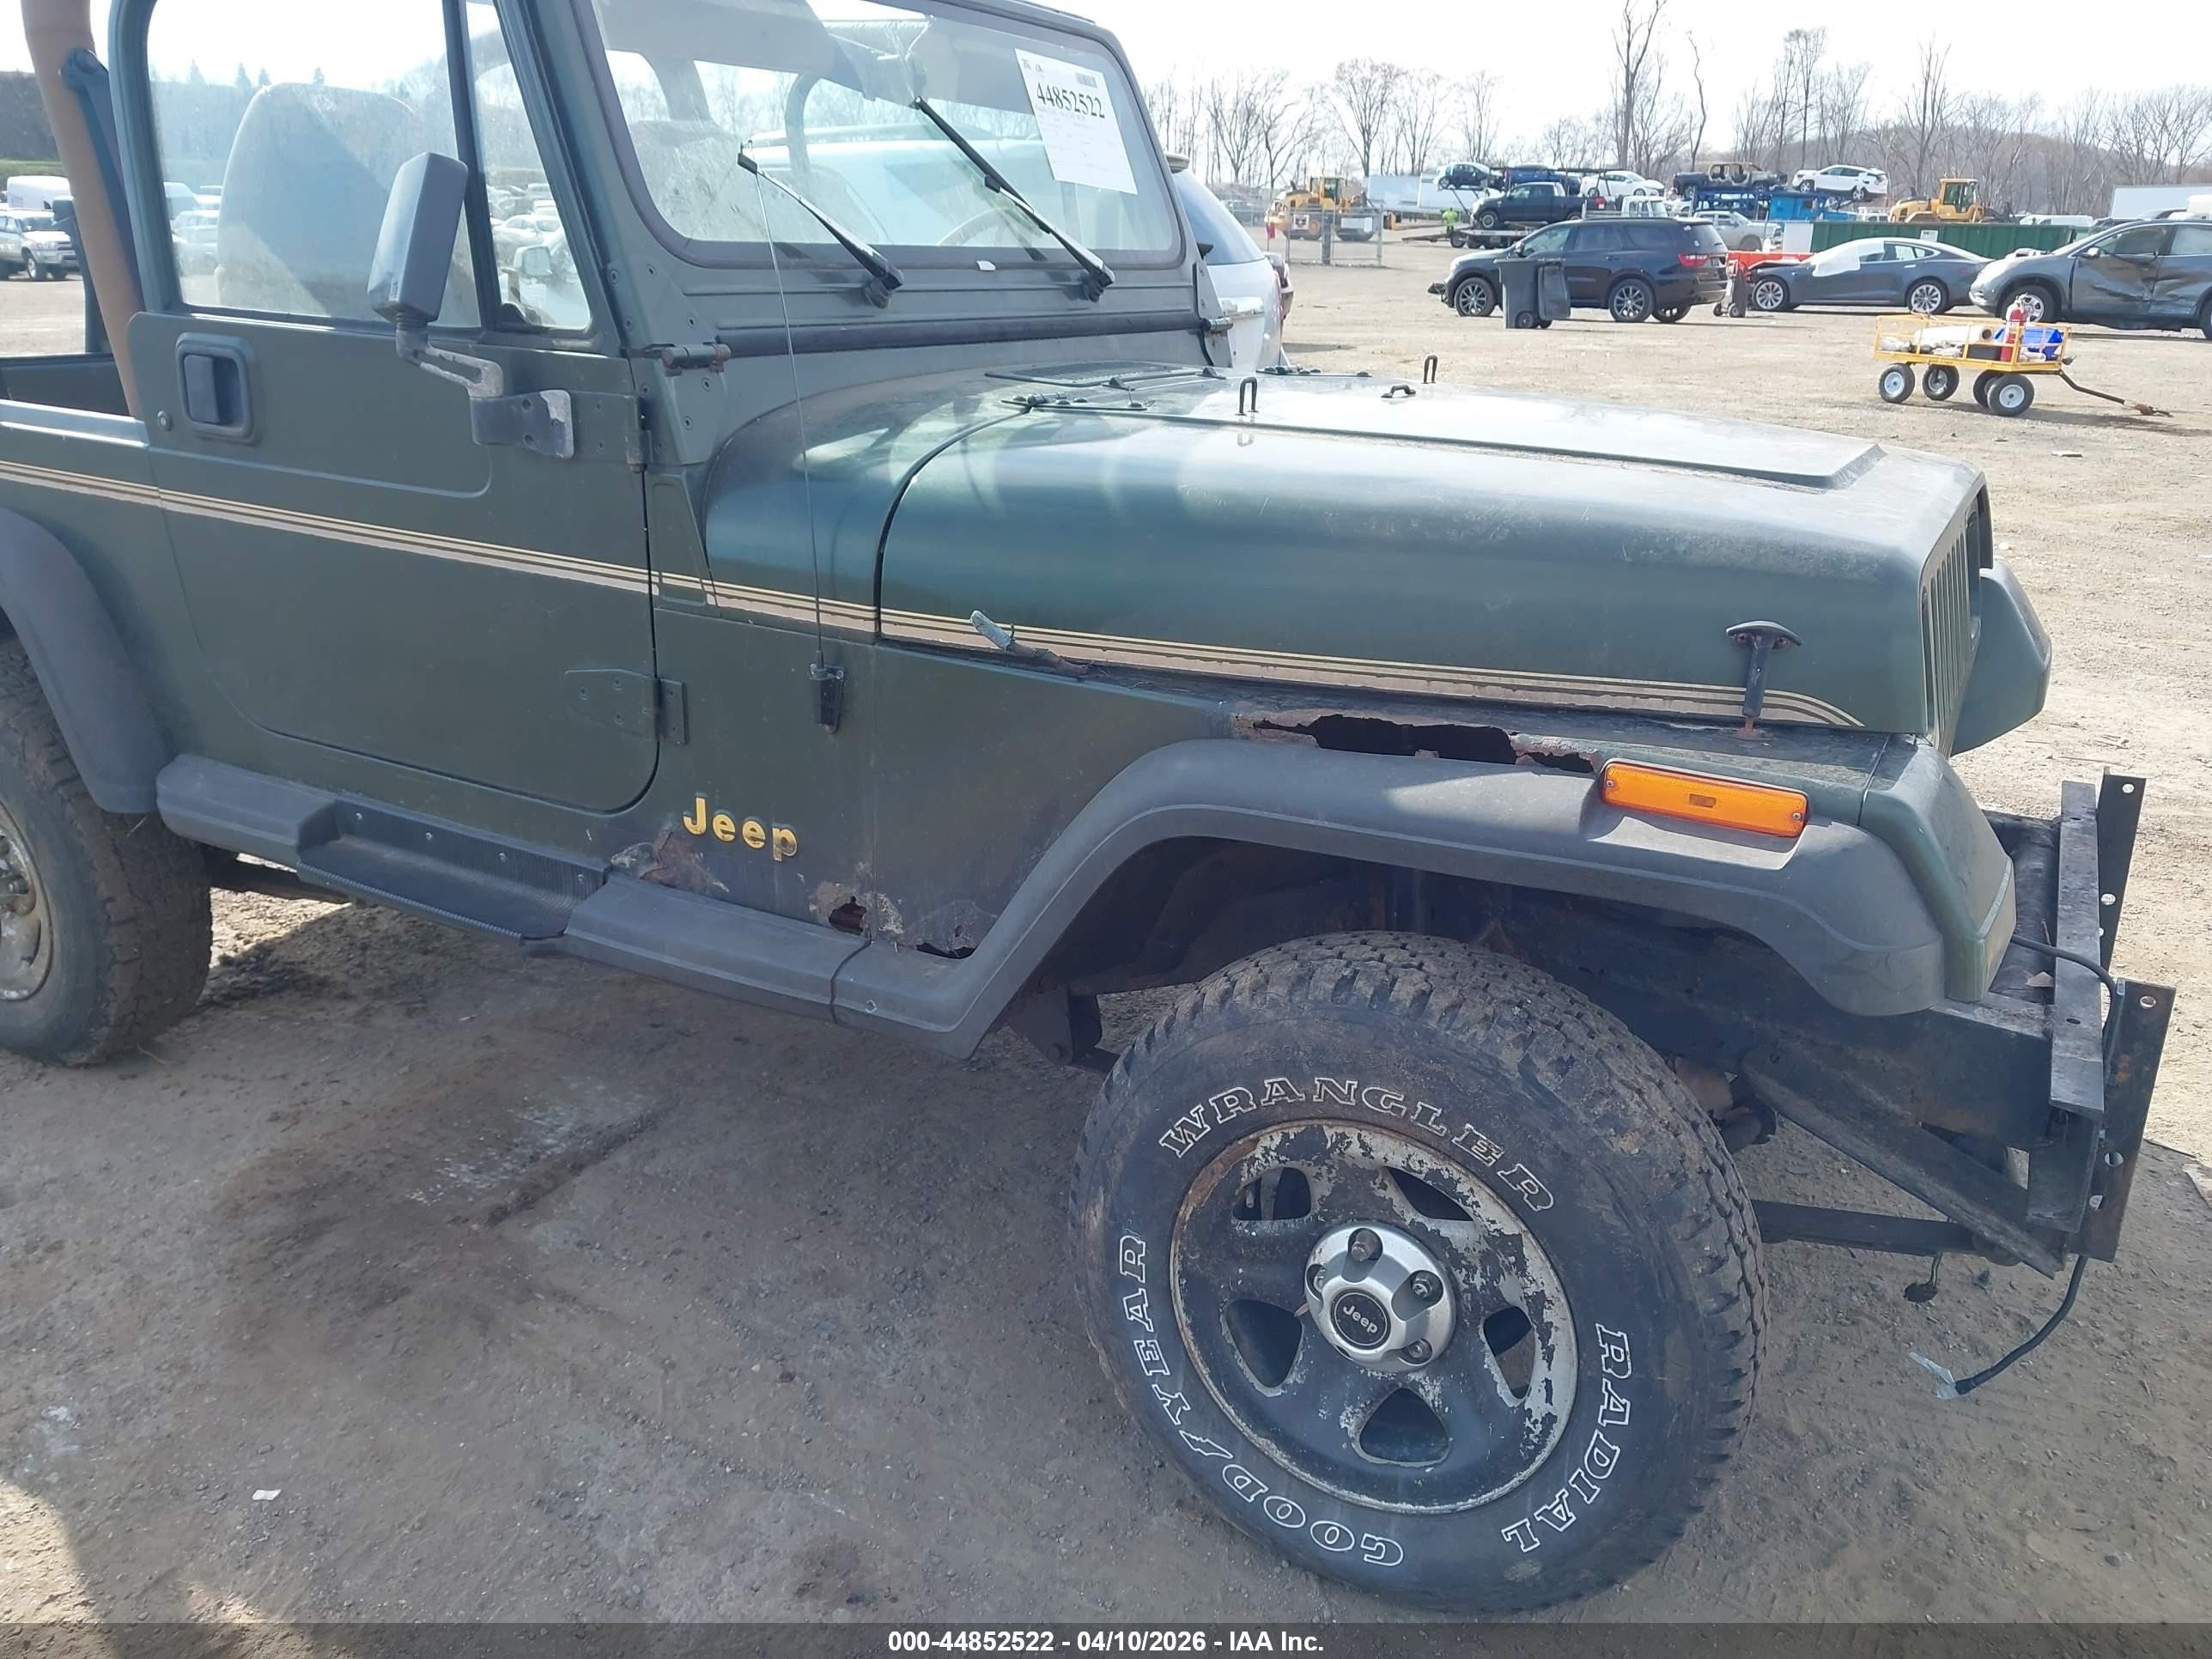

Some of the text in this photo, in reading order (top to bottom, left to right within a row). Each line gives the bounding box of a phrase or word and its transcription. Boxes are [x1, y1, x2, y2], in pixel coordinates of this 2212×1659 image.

[1036, 82, 1105, 118] 44852522
[683, 797, 798, 862] Jeep
[1158, 1077, 1554, 1212] WRANGLER
[1343, 1305, 1378, 1334] Jeep
[1119, 1234, 1404, 1567] GOODYEAR
[1501, 1322, 1632, 1553] RADIAL
